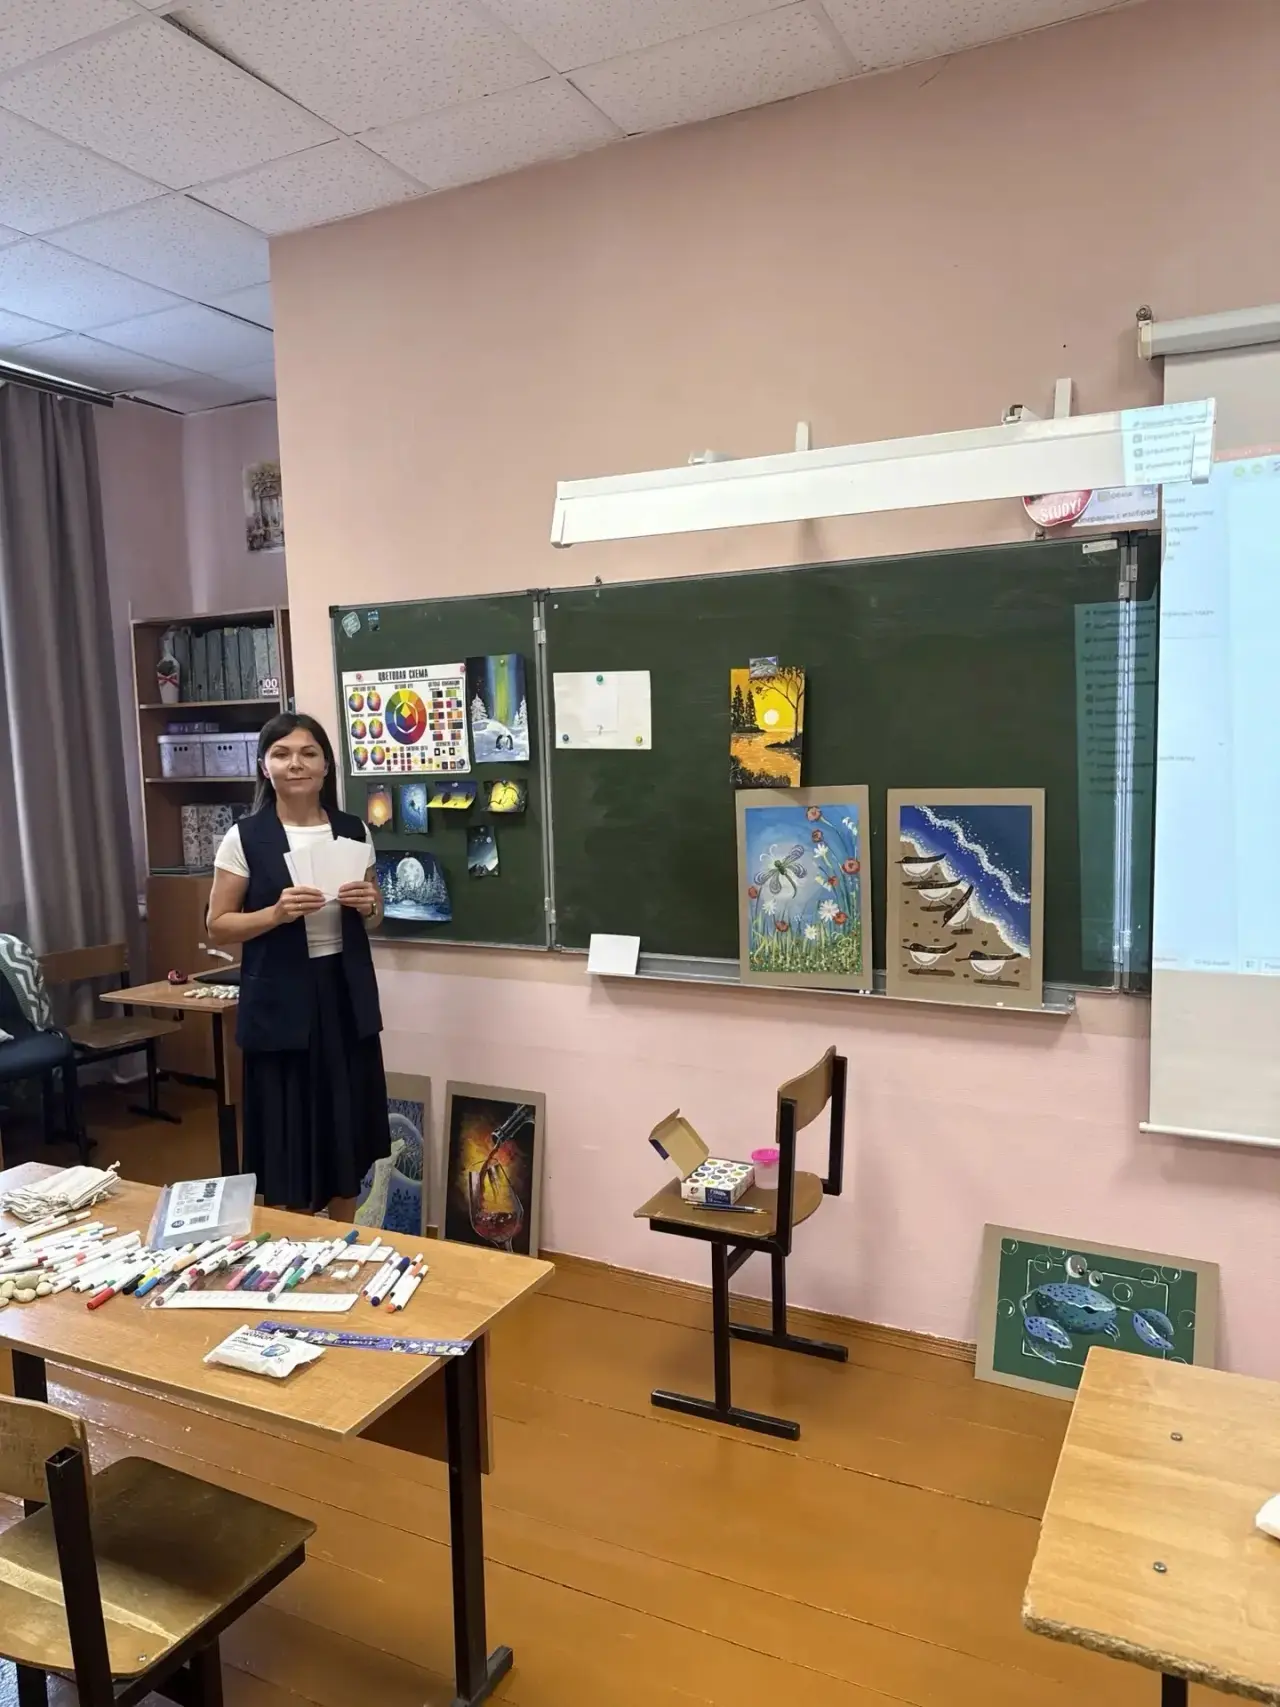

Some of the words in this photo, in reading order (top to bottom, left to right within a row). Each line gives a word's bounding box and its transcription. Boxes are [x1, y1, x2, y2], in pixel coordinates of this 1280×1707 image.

[1040, 496, 1082, 523] STUDY!
[378, 670, 407, 682] ЦВЕТОВАЯ
[408, 668, 428, 680] СХЕМА
